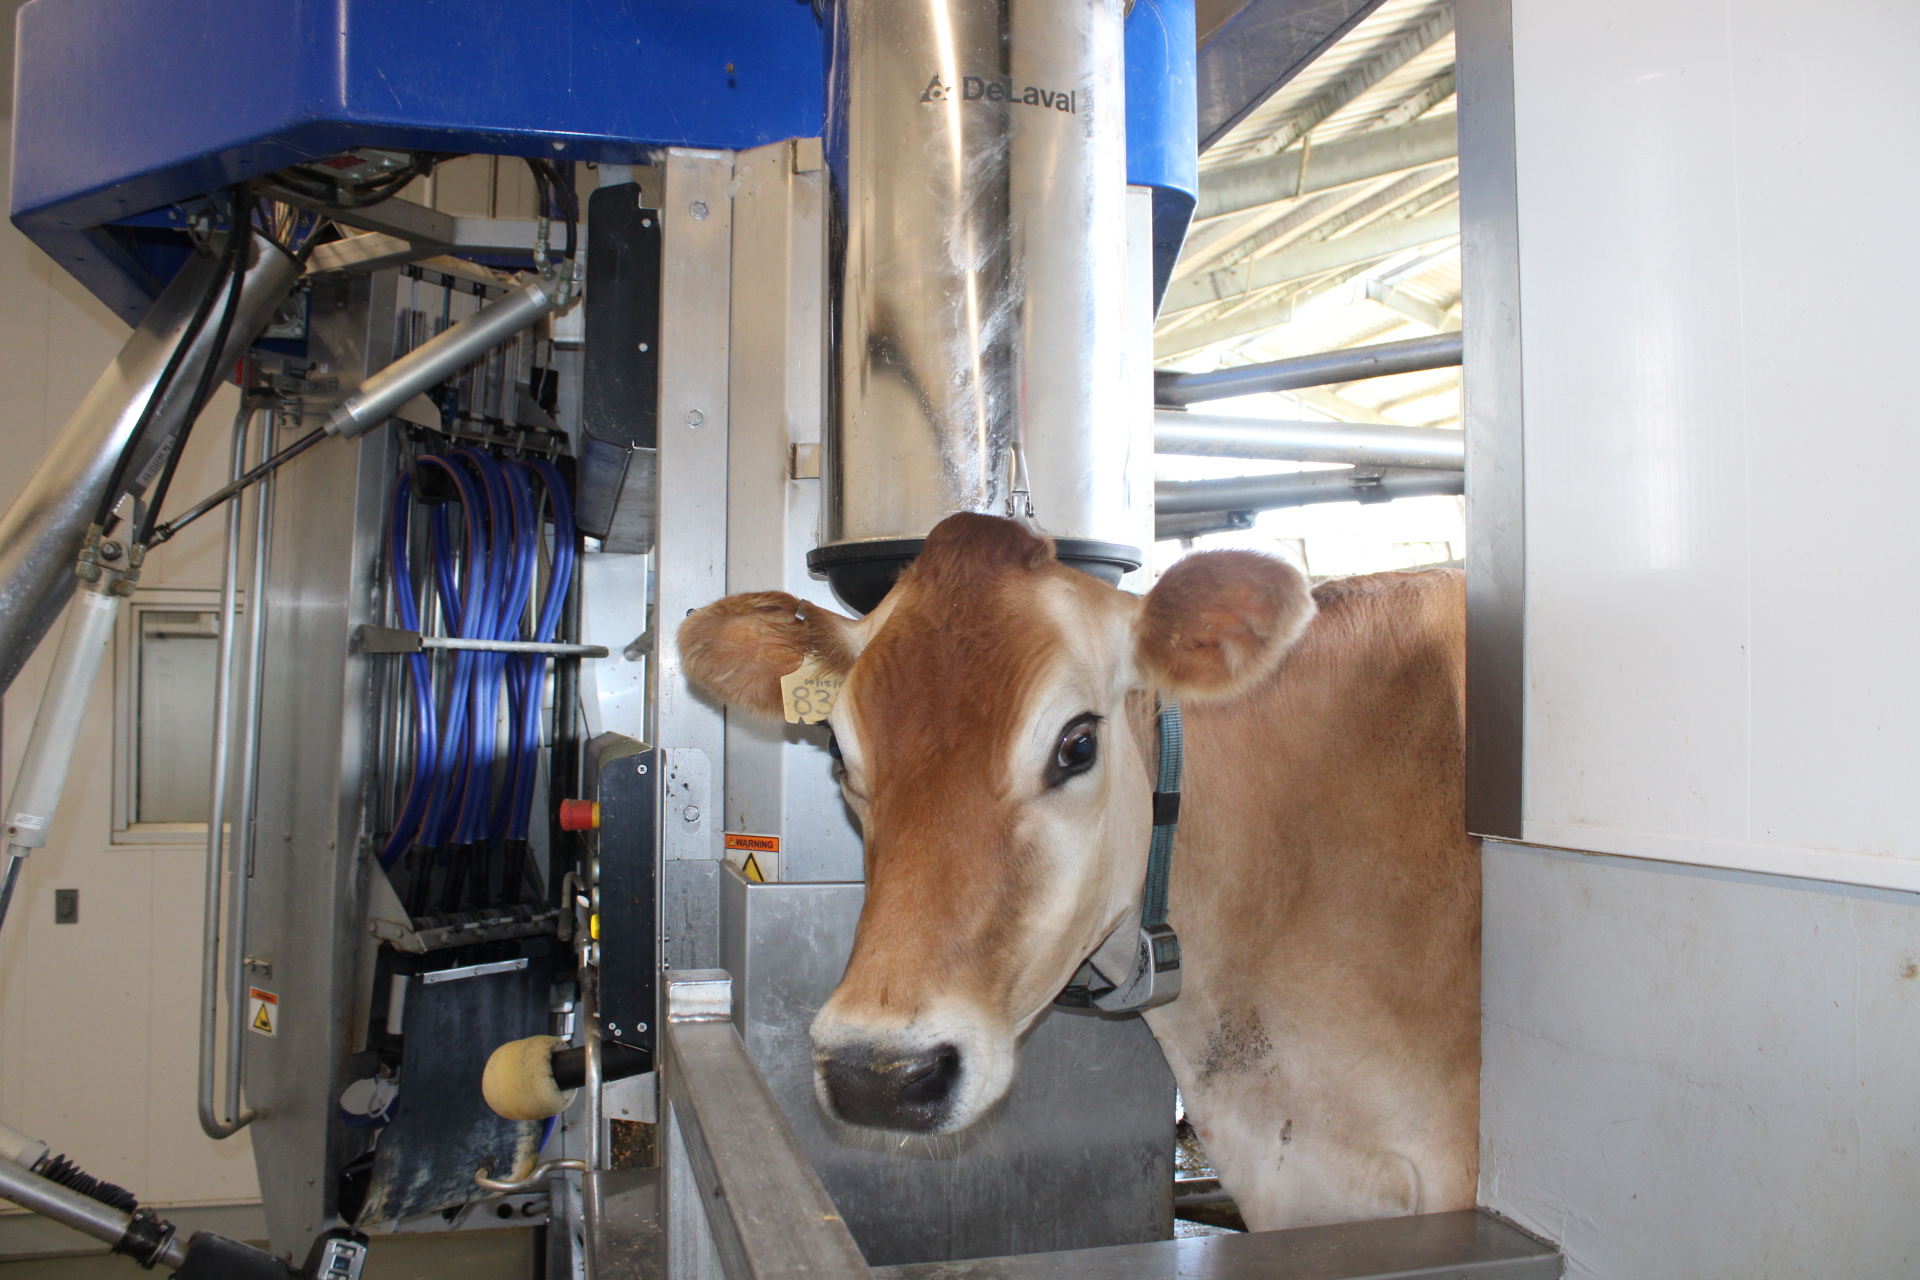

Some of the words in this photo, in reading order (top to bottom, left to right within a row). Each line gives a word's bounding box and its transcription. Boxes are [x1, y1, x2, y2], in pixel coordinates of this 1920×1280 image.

[962, 75, 1076, 114] DeLaval
[791, 686, 839, 716] 83
[735, 838, 774, 849] WARNING
